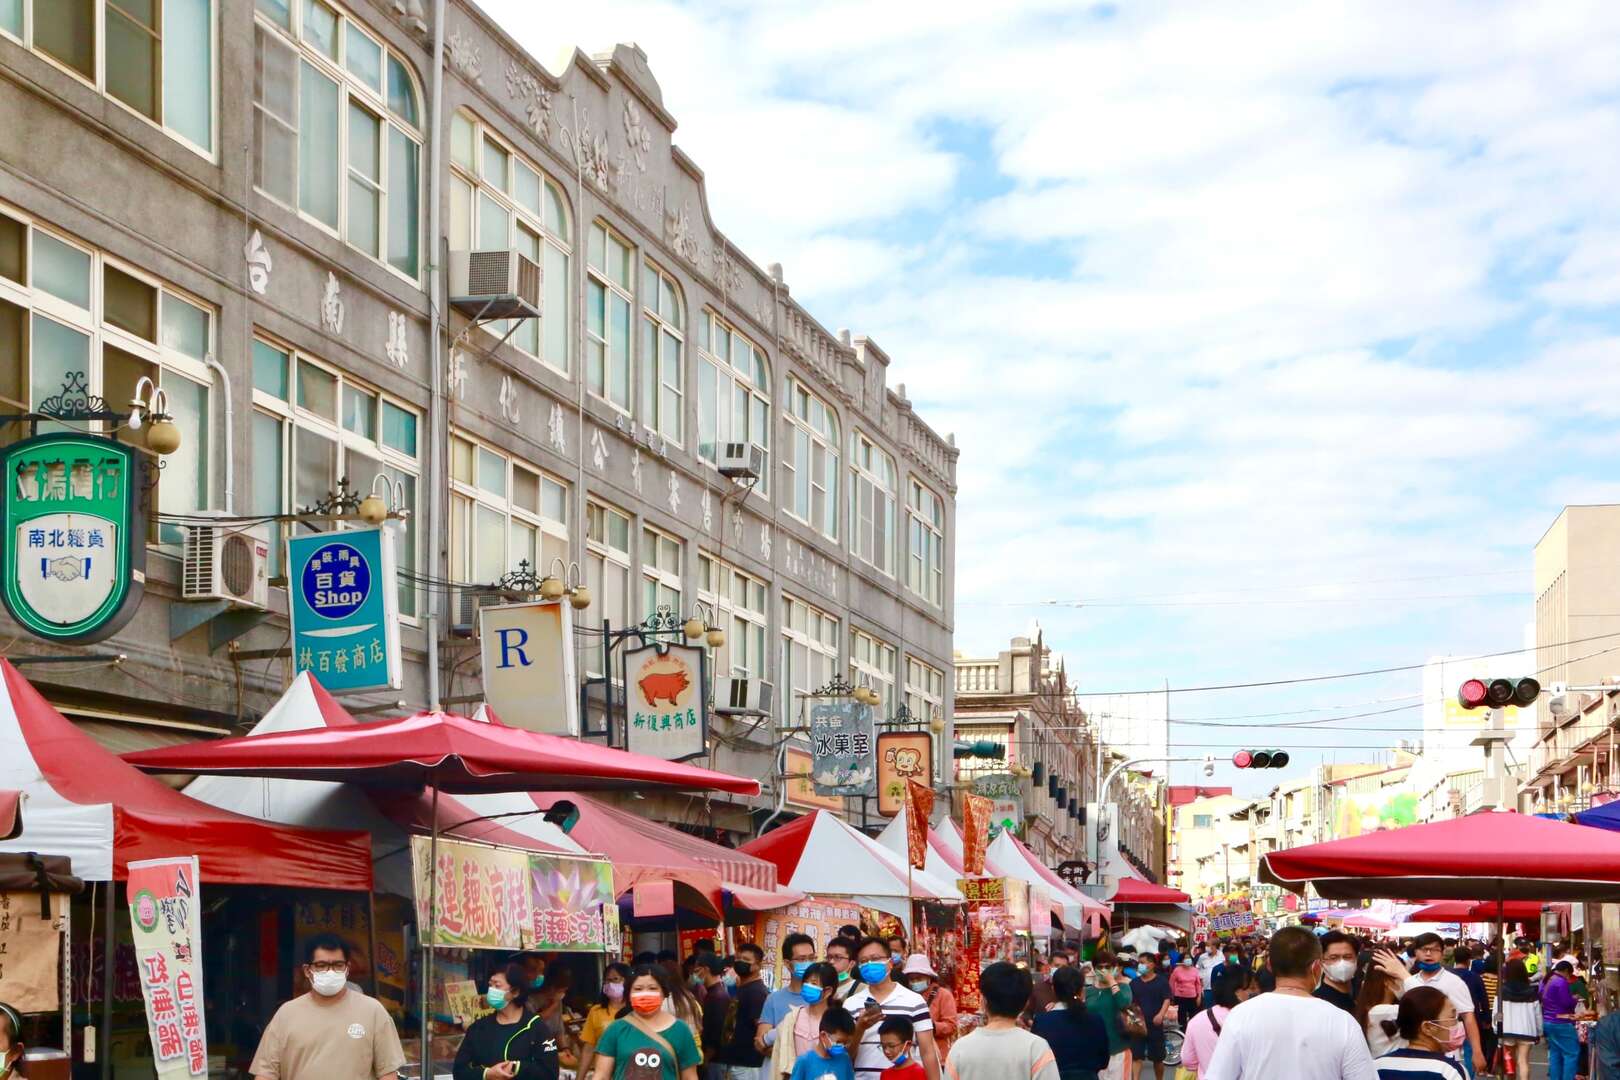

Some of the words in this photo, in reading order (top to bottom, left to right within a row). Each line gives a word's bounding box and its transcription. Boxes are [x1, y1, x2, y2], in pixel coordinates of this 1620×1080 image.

[316, 571, 357, 589] 百貨
[314, 590, 363, 607] Shop
[299, 637, 384, 673] 林百發商店
[495, 628, 534, 668] R
[814, 731, 870, 758] 冰菓室
